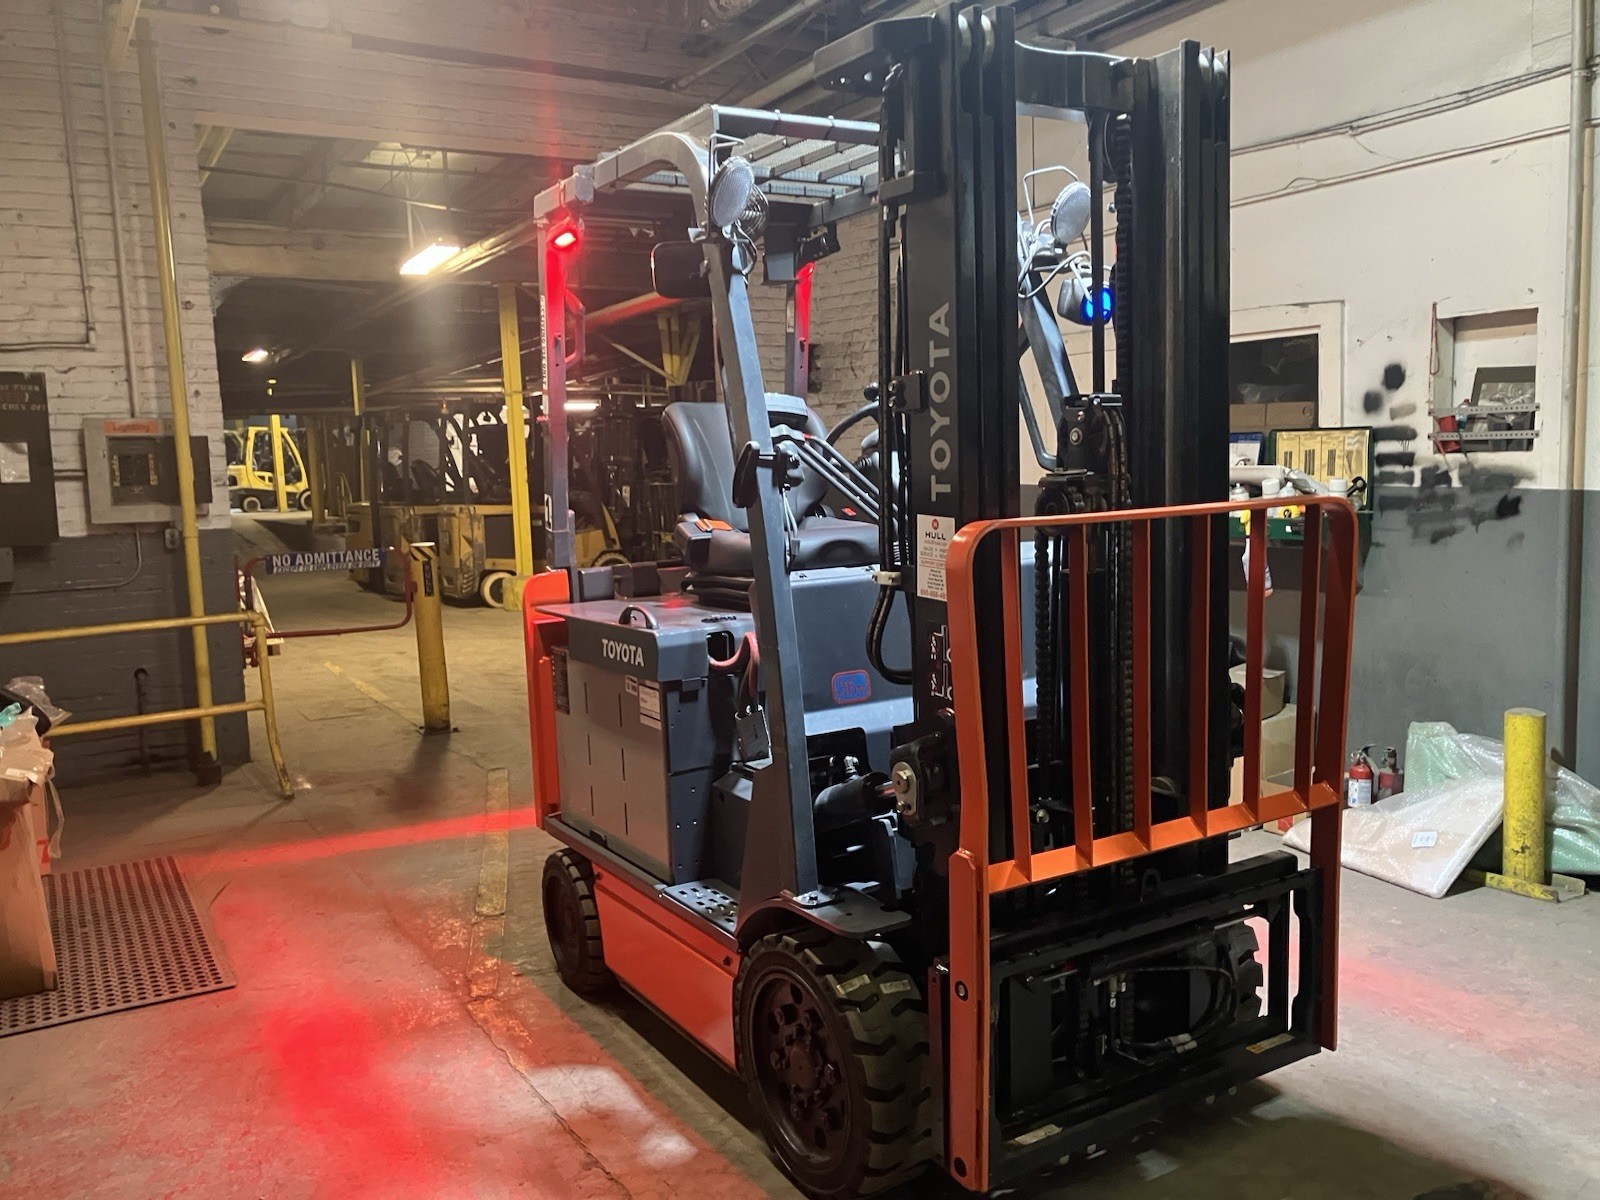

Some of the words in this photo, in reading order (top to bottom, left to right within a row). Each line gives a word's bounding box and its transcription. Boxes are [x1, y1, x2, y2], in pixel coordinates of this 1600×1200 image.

[929, 302, 951, 501] TOYOTA
[925, 531, 946, 541] HULL
[272, 554, 291, 567] NO
[295, 548, 380, 565] ADMITTANCE
[602, 638, 644, 667] TOYOTA
